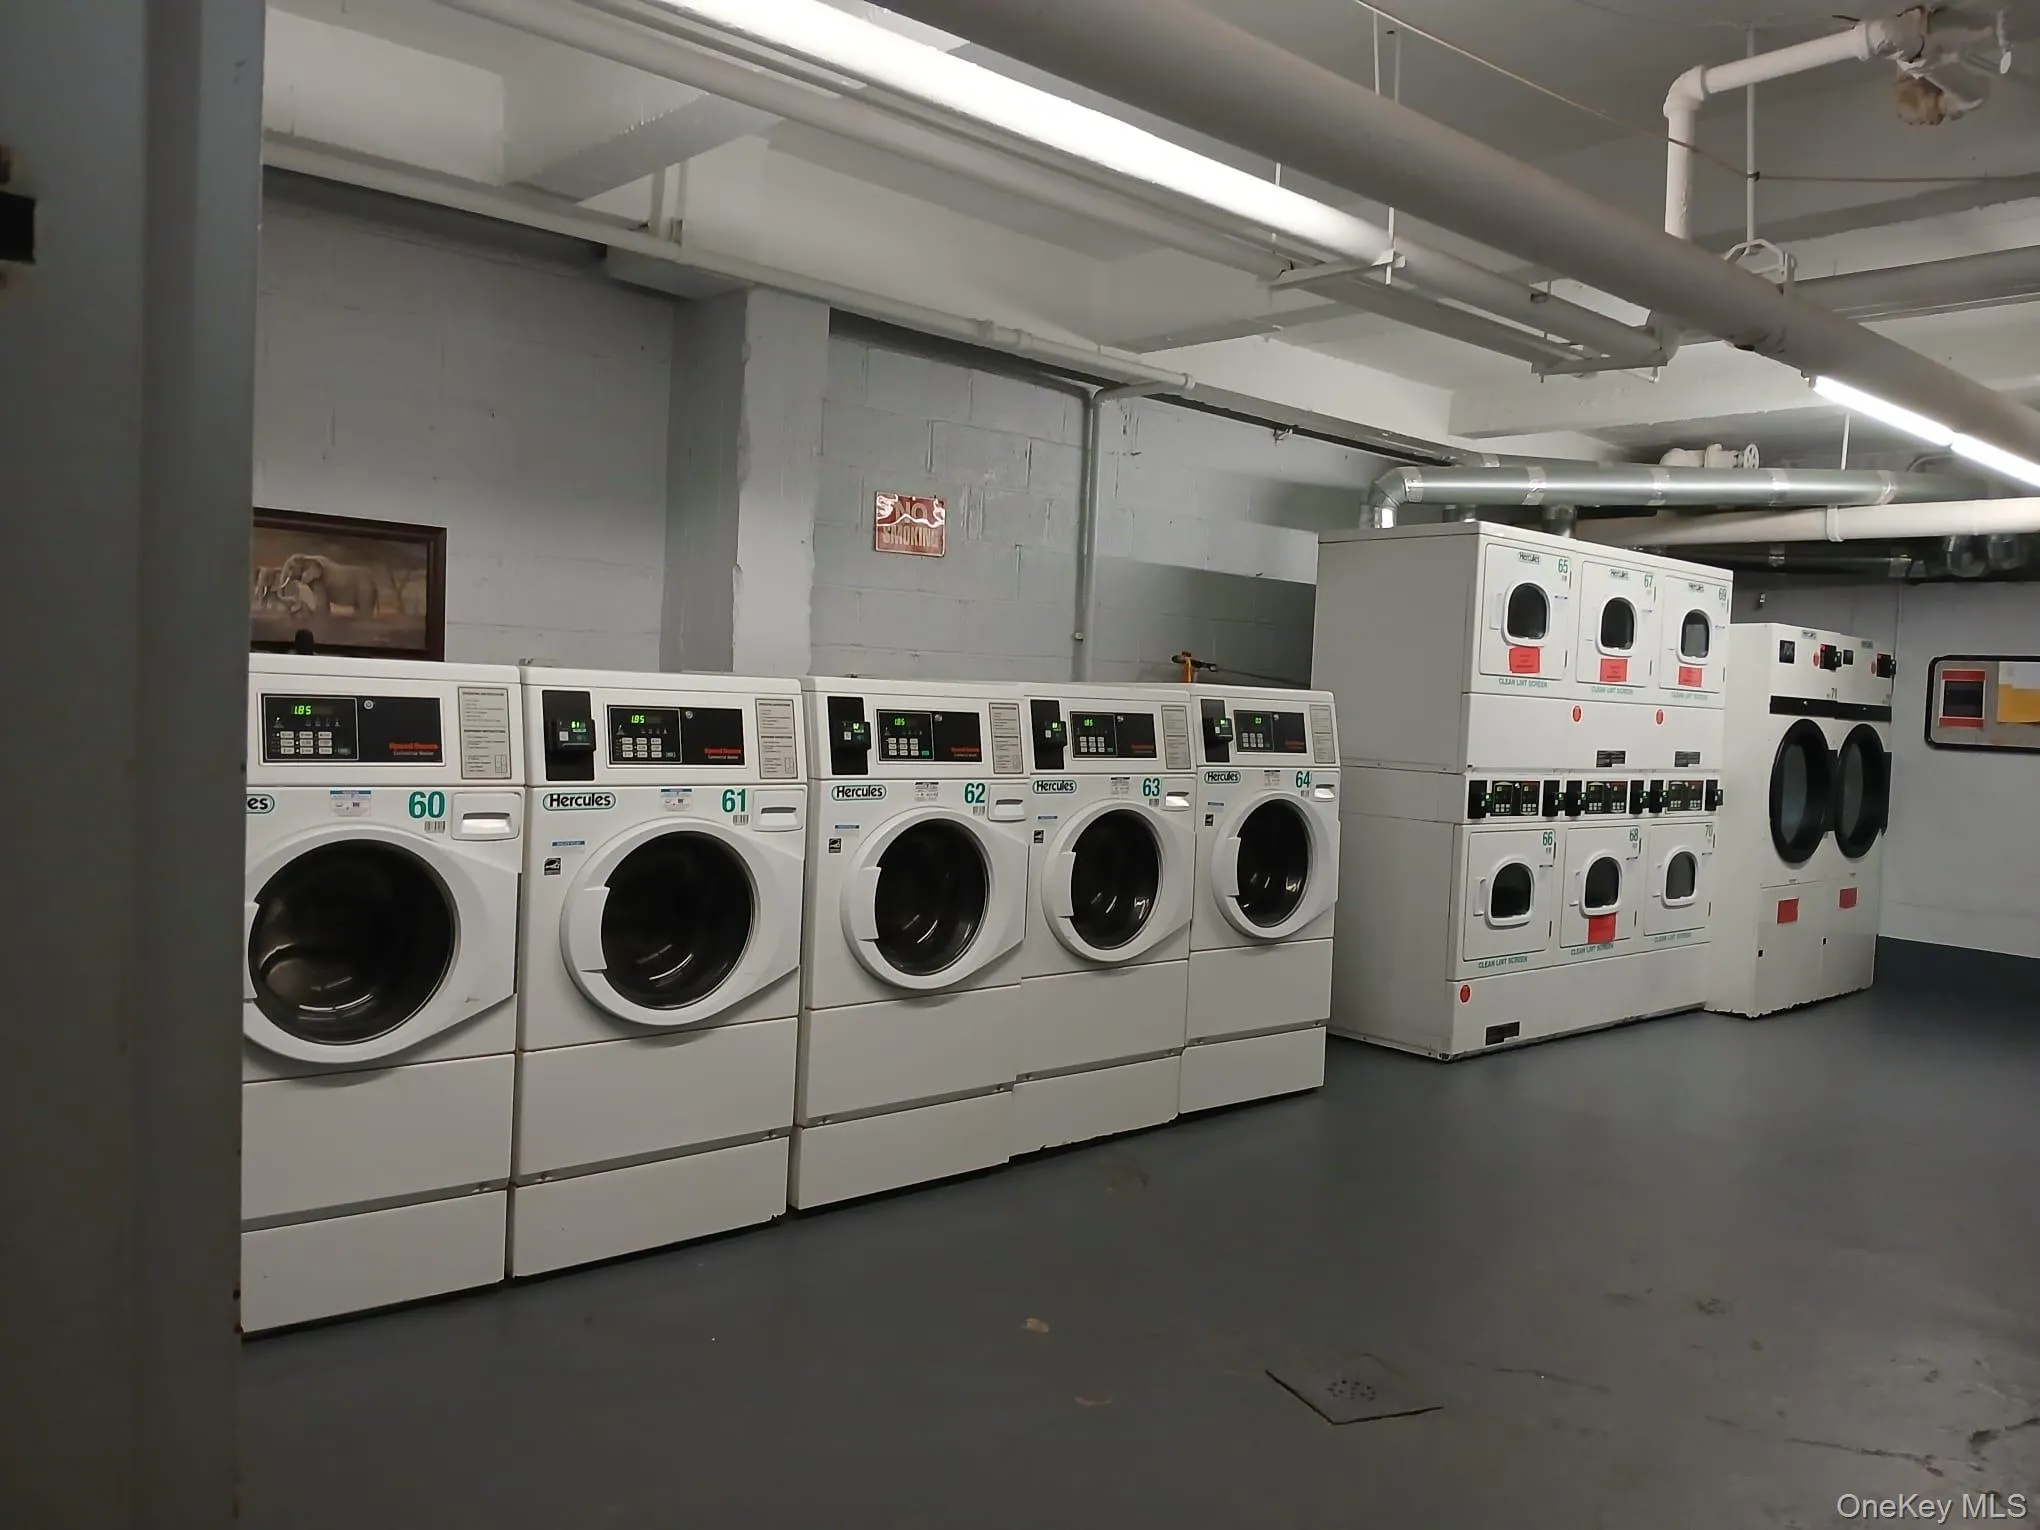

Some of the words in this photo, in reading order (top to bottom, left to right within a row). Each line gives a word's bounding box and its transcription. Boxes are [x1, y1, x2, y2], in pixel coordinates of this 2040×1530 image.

[895, 501, 928, 521] NO
[882, 524, 939, 547] SMOKING
[1558, 559, 1569, 574] 65
[1644, 574, 1653, 588] 67
[1206, 771, 1240, 782] Hercules
[1295, 770, 1311, 789] 64
[836, 785, 884, 799] Hercules
[964, 783, 986, 804] 62
[1035, 780, 1075, 792] Hercules
[1142, 777, 1160, 797] 63
[408, 791, 446, 819] 60
[549, 793, 612, 808] Hercules
[721, 788, 747, 813] 61
[1542, 831, 1553, 847] 66
[1629, 827, 1639, 842] 68
